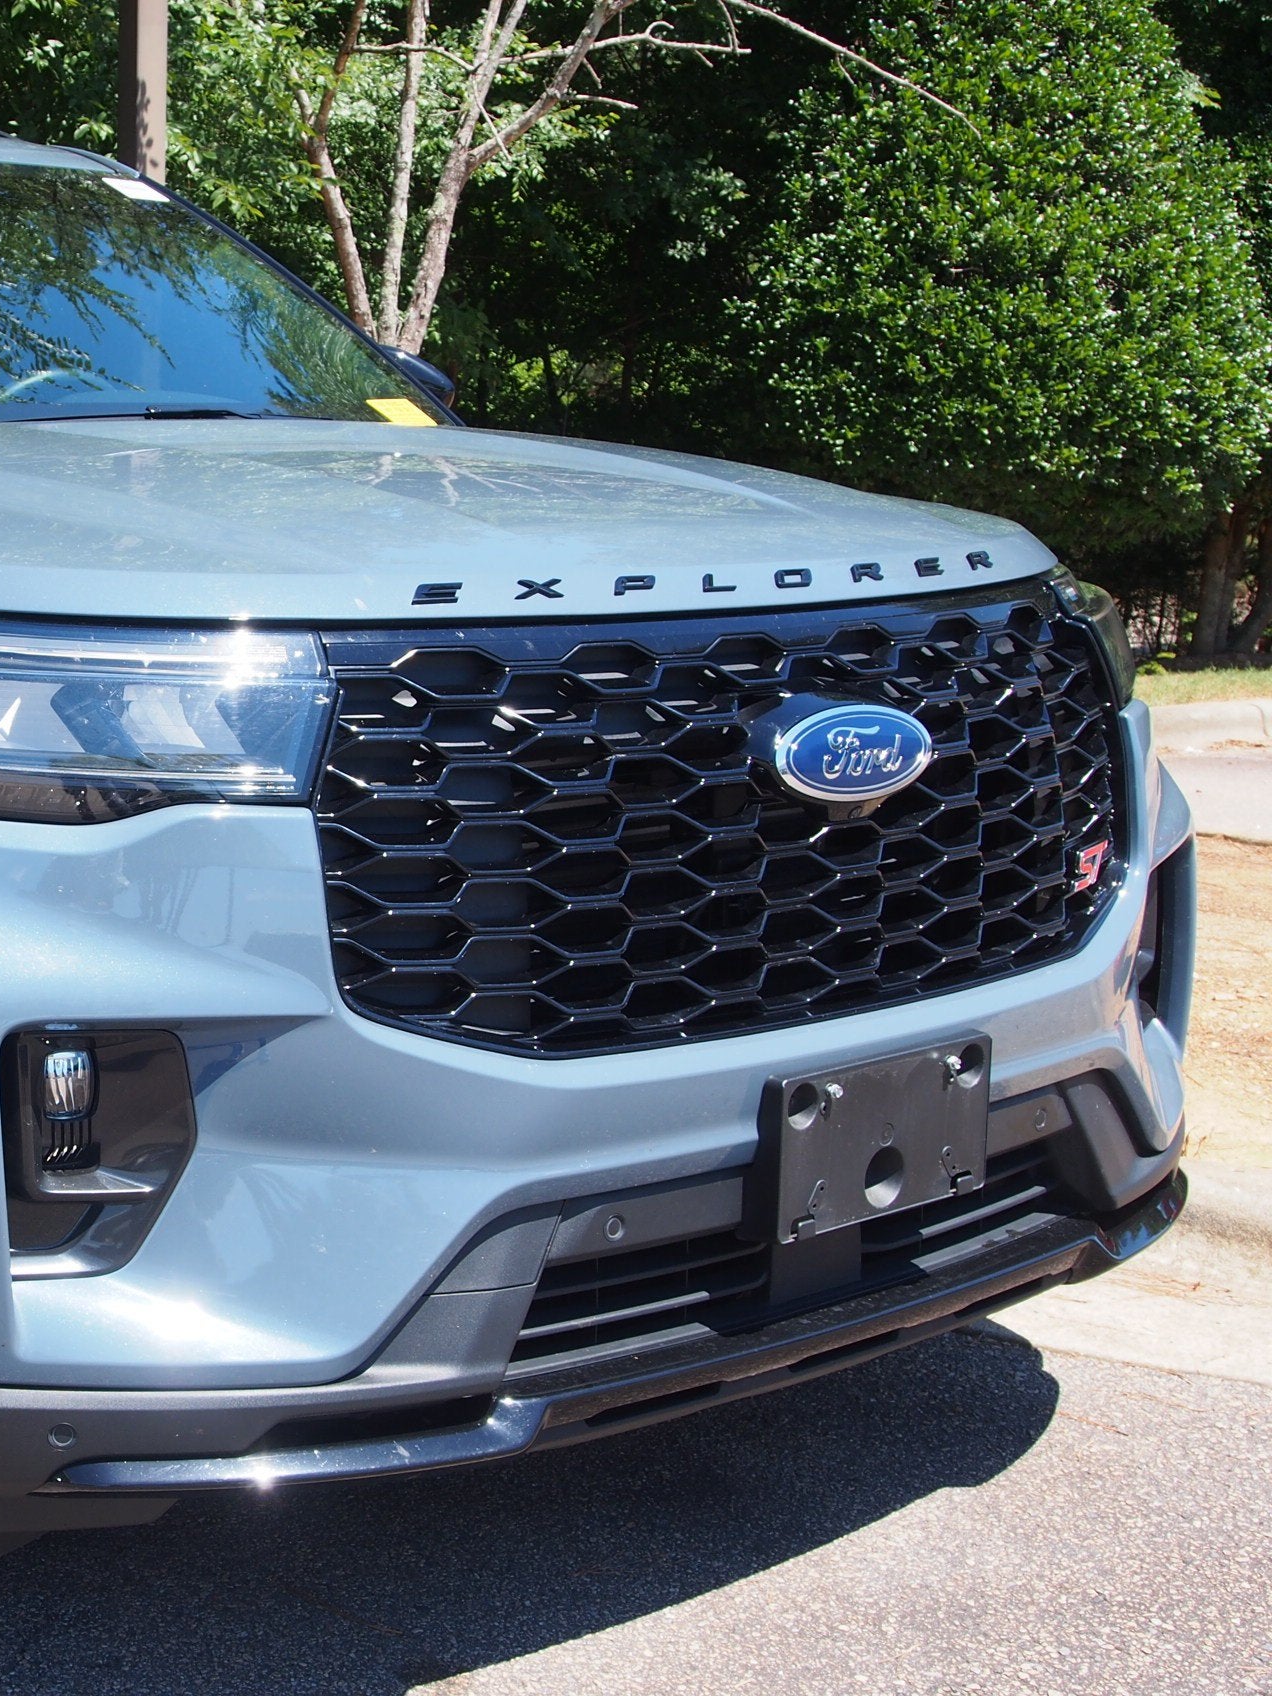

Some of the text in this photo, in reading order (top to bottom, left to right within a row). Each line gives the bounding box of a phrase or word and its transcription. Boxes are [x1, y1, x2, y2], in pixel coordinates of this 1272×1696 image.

[411, 550, 993, 606] EXPLORER
[822, 725, 903, 780] Ford
[1074, 839, 1109, 892] ST
